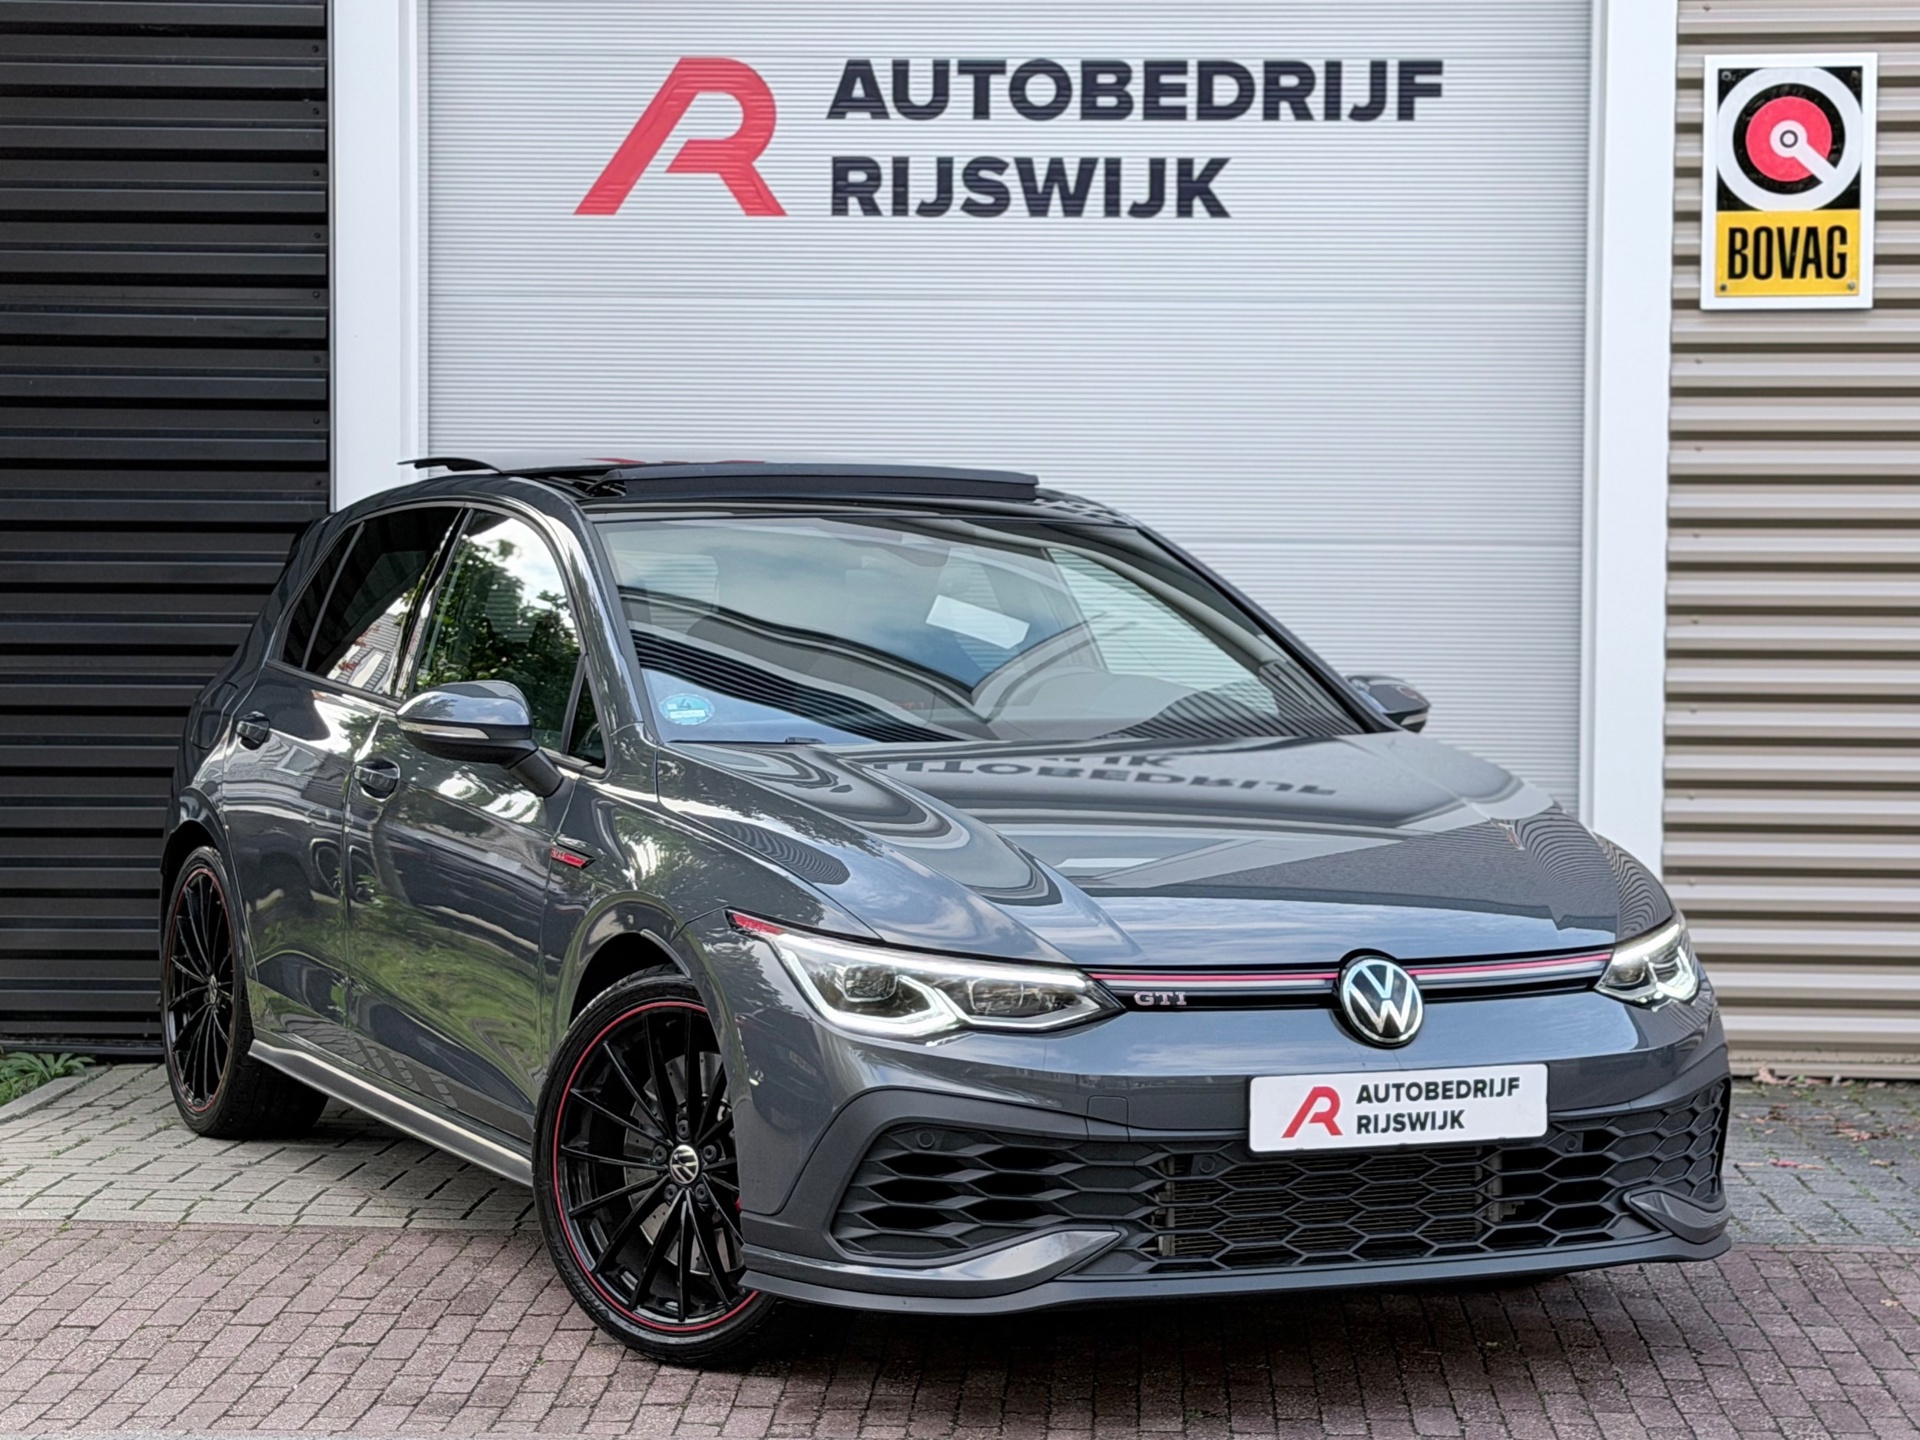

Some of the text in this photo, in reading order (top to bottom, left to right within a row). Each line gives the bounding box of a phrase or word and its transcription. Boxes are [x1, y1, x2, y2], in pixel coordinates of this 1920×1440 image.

[827, 59, 1443, 121] AUTOBEDRIJF
[831, 156, 1230, 218] RIJSWIJK
[1727, 225, 1848, 281] BOVAG
[1133, 990, 1188, 1006] GTI
[1355, 1076, 1521, 1105] AUTOBEDRIJF
[1356, 1109, 1466, 1135] RIJSWIJK
